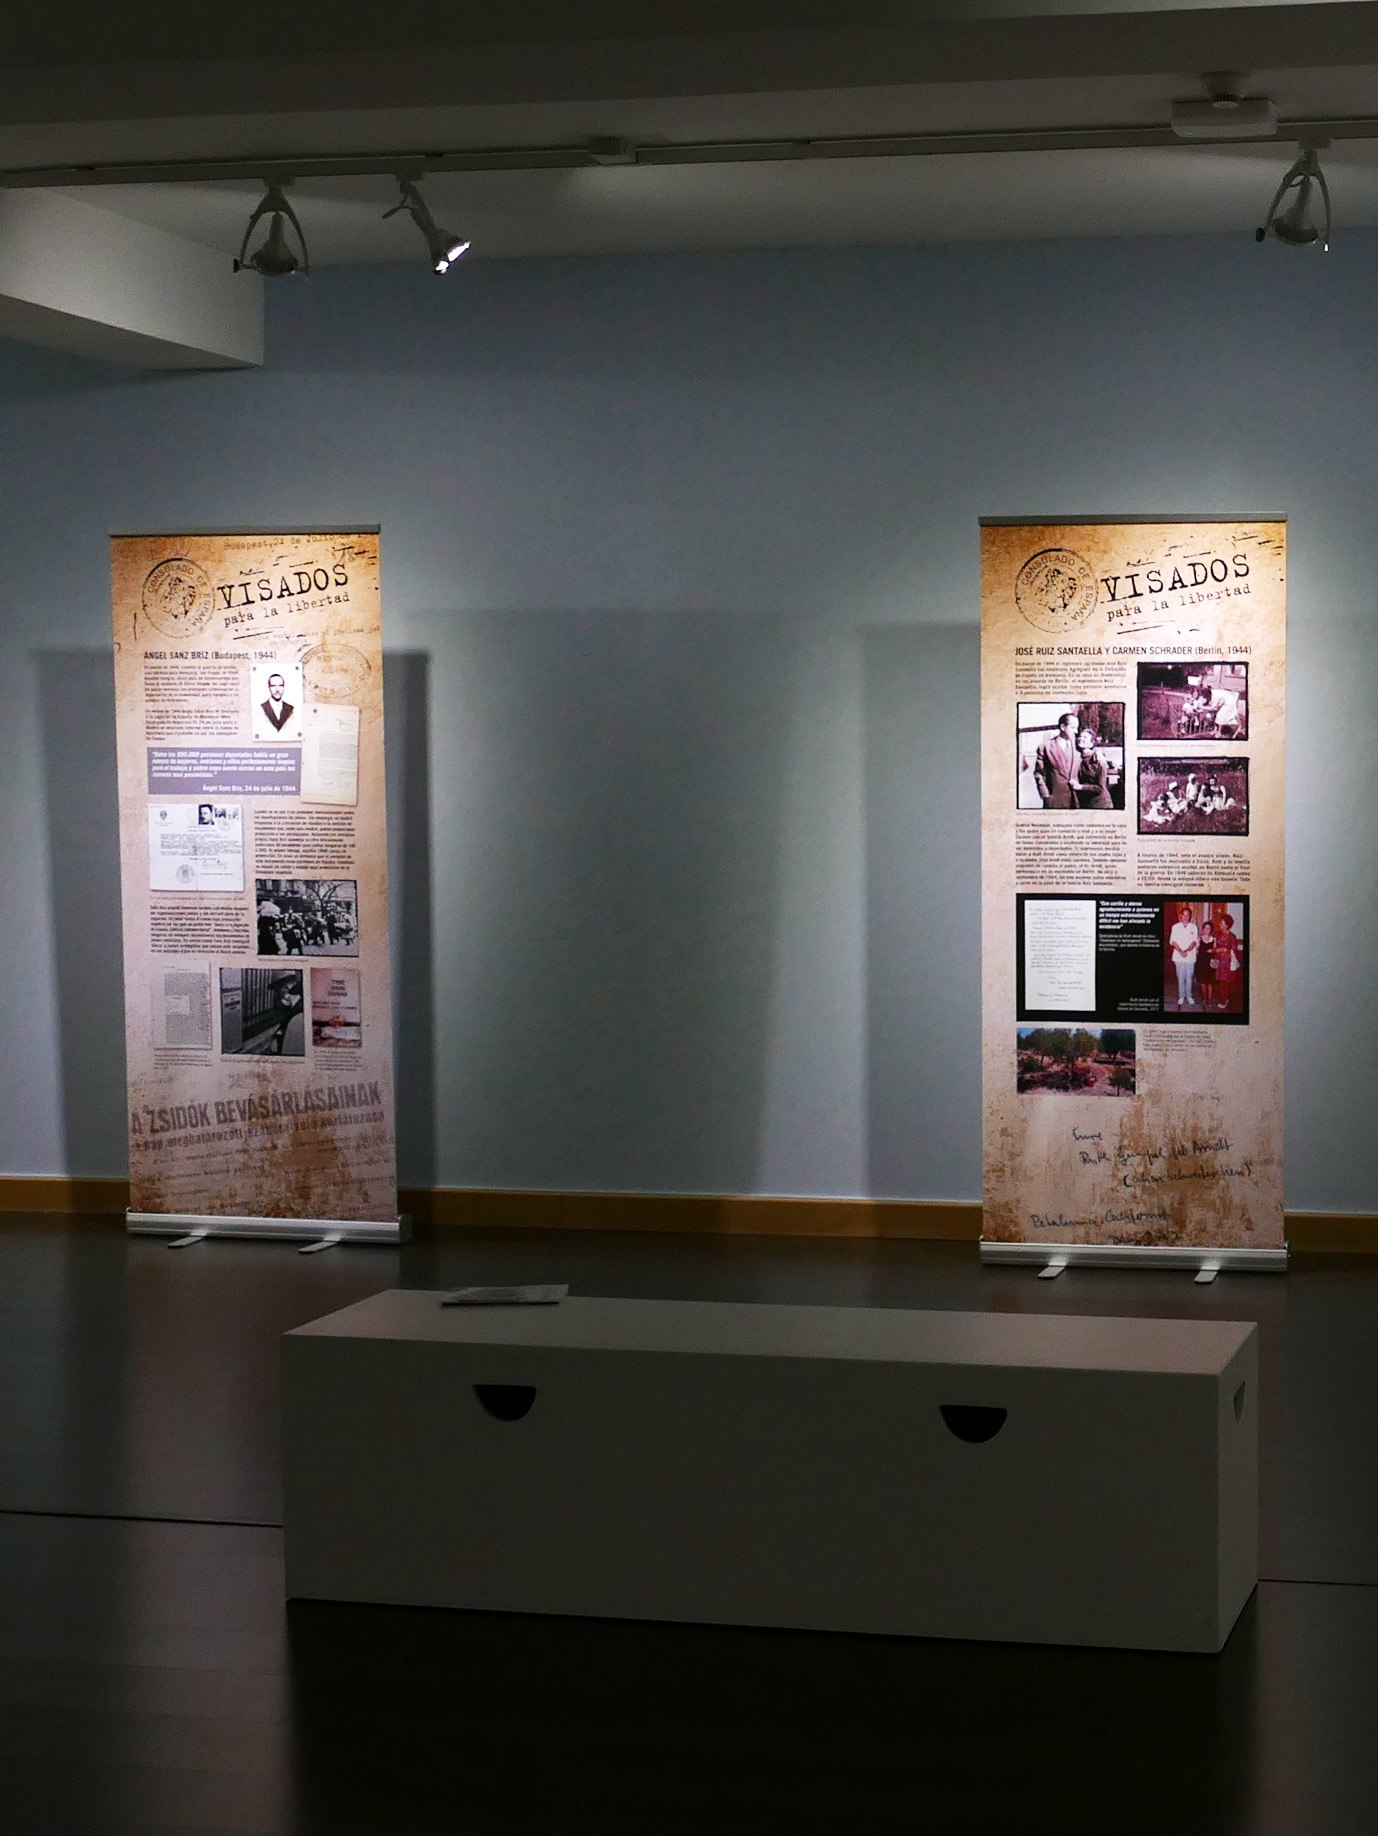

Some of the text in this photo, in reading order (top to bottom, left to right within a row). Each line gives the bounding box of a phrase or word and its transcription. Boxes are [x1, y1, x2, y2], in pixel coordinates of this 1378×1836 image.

[148, 564, 194, 592] CONSULADO
[197, 575, 207, 587] DE
[217, 563, 348, 610] VISADOS
[1021, 555, 1093, 621] CONSULADO DE ESPAÑA
[1100, 554, 1249, 601] VISADOS
[224, 592, 350, 628] para la libertad
[1107, 584, 1251, 622] para la libertad
[170, 651, 189, 660] SANZ
[191, 651, 208, 660] BRIZ
[254, 651, 276, 659] 1944)
[1015, 646, 1252, 656] JOSÉ RUIZ SANTAELLA Y CARMEN SCHRADER (Berlin, 1944)
